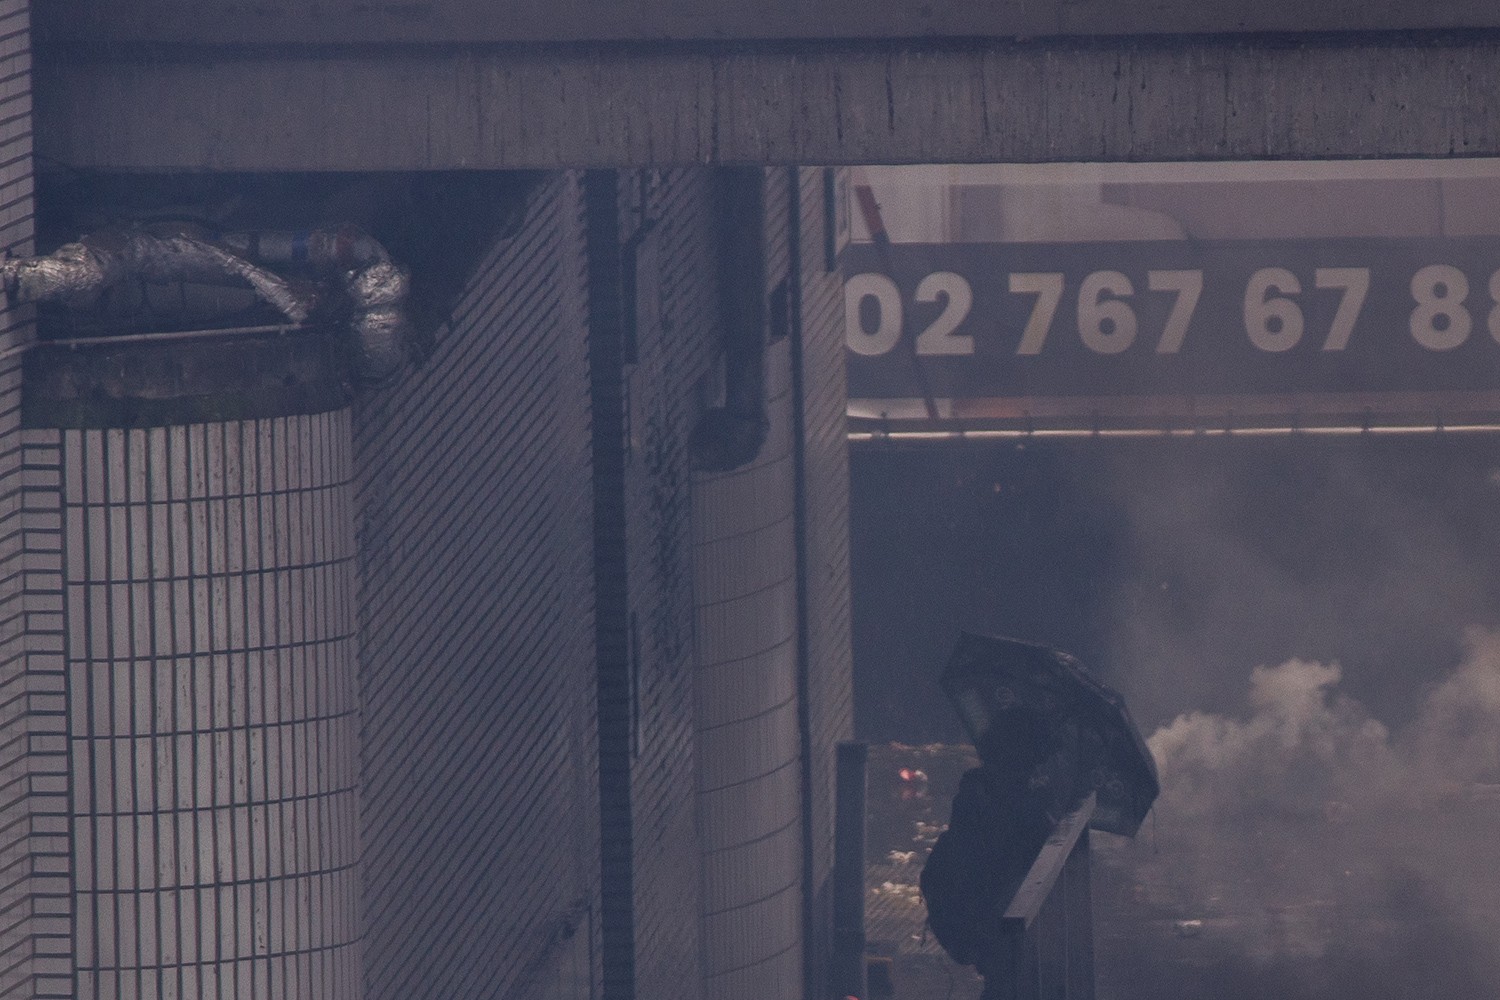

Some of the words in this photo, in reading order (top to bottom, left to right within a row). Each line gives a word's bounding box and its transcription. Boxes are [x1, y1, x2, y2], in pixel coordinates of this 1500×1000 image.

[845, 271, 974, 355] 02
[1009, 269, 1204, 355] 767
[1244, 267, 1370, 352] 67
